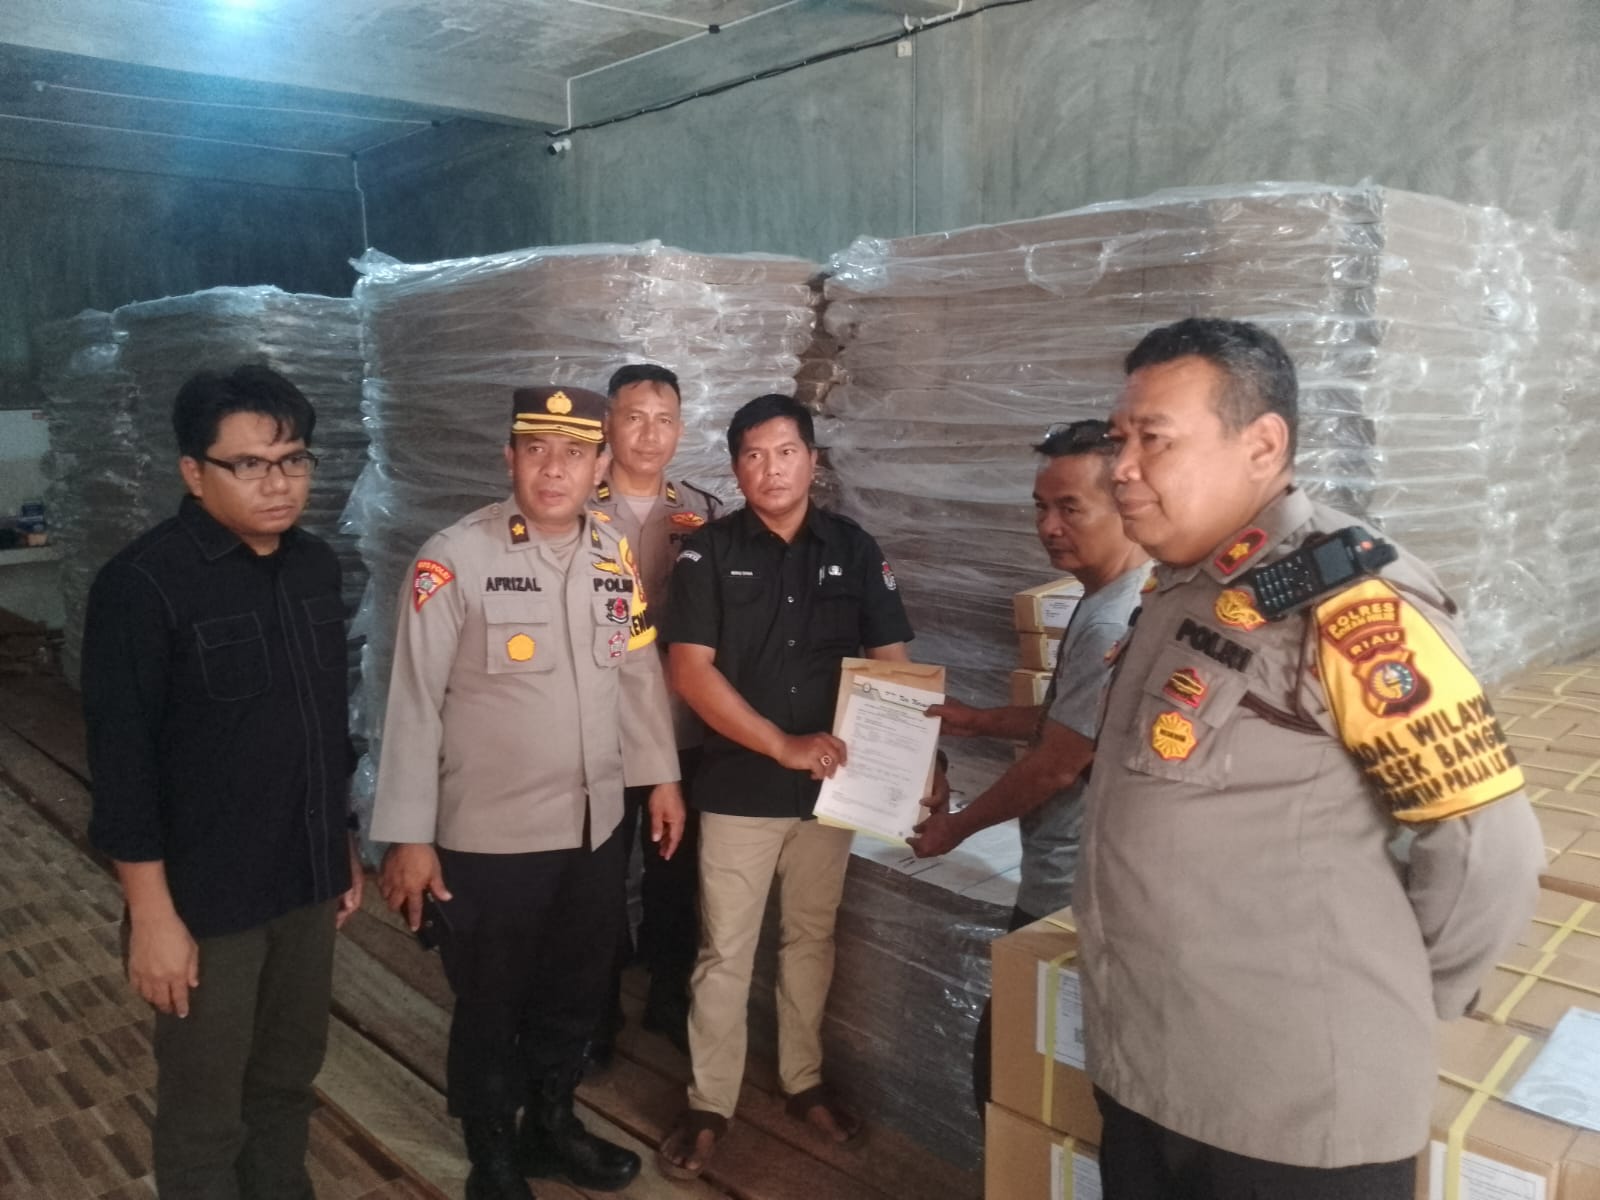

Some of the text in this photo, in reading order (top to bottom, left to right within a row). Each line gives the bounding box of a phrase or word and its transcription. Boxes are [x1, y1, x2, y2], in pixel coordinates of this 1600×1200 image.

[486, 576, 541, 592] AFRIZAL
[1327, 601, 1396, 636] POLRES
[1176, 617, 1253, 672] POLRI
[1349, 631, 1401, 656] RIAU
